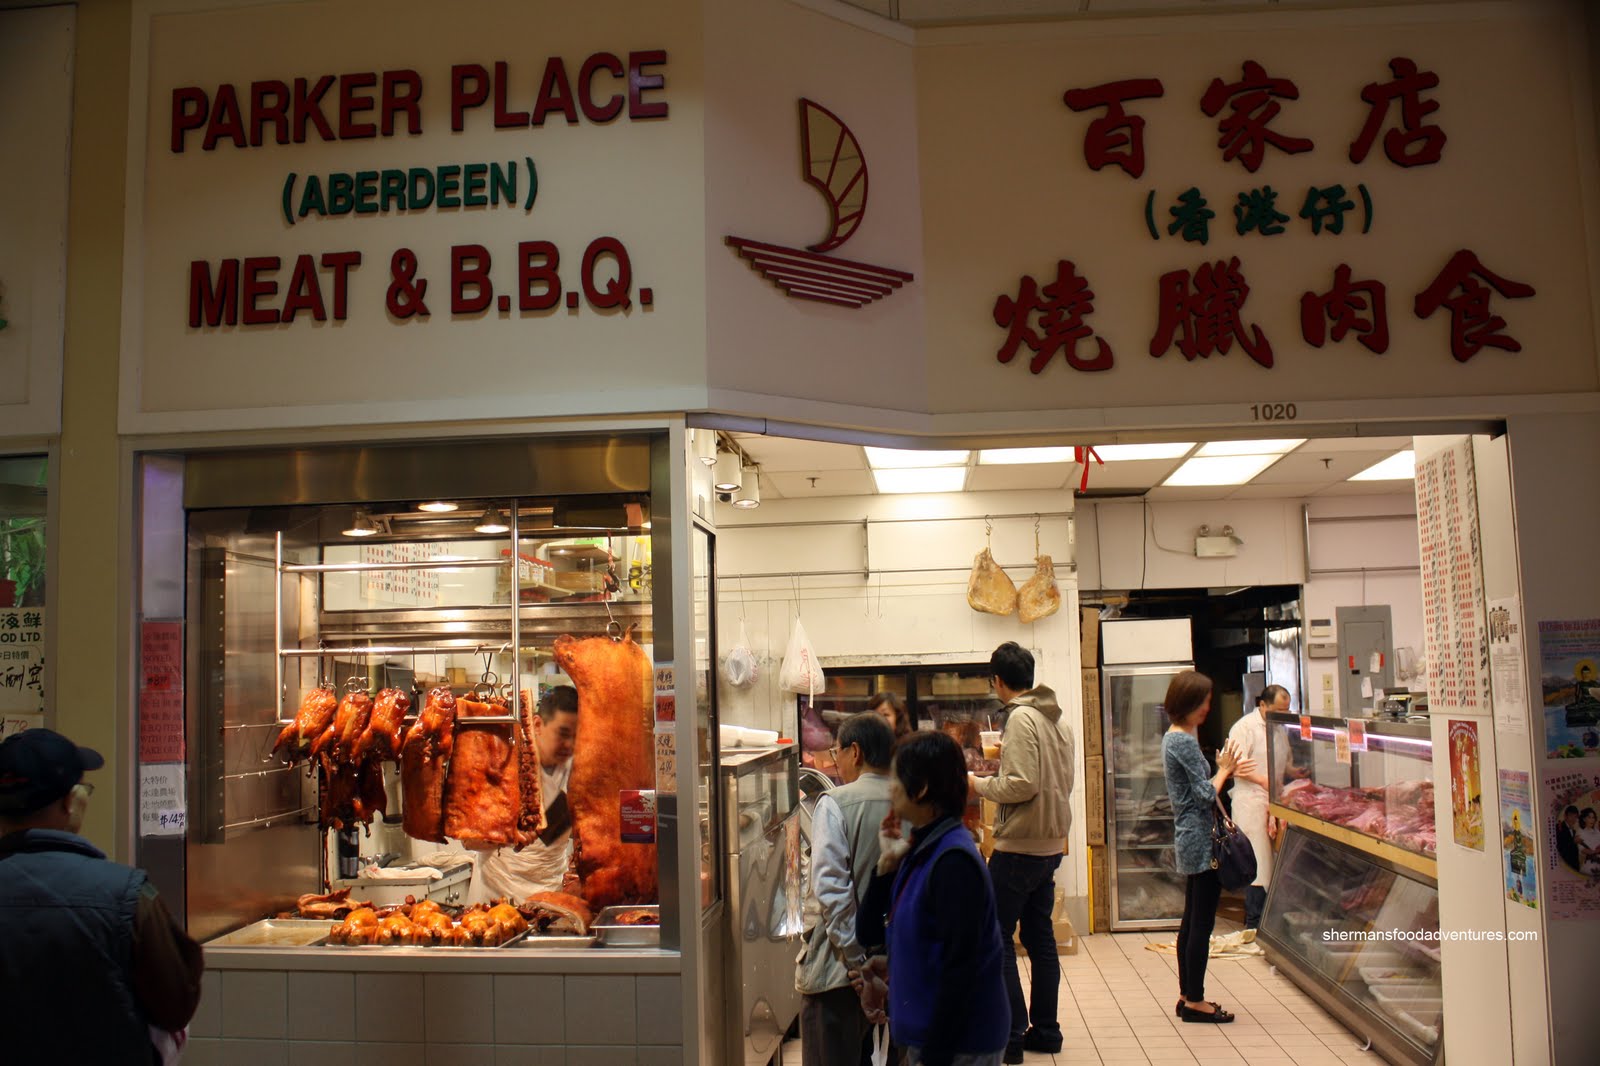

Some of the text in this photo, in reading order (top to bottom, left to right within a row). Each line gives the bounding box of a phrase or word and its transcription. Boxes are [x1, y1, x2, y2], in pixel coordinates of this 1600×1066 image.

[171, 50, 669, 153] PARKER PLACE
[1063, 57, 1447, 179] 百家店
[282, 156, 538, 225] (ABERDEEN)
[188, 237, 653, 328] MEAT & B.B.Q.
[1250, 403, 1297, 420] 1020
